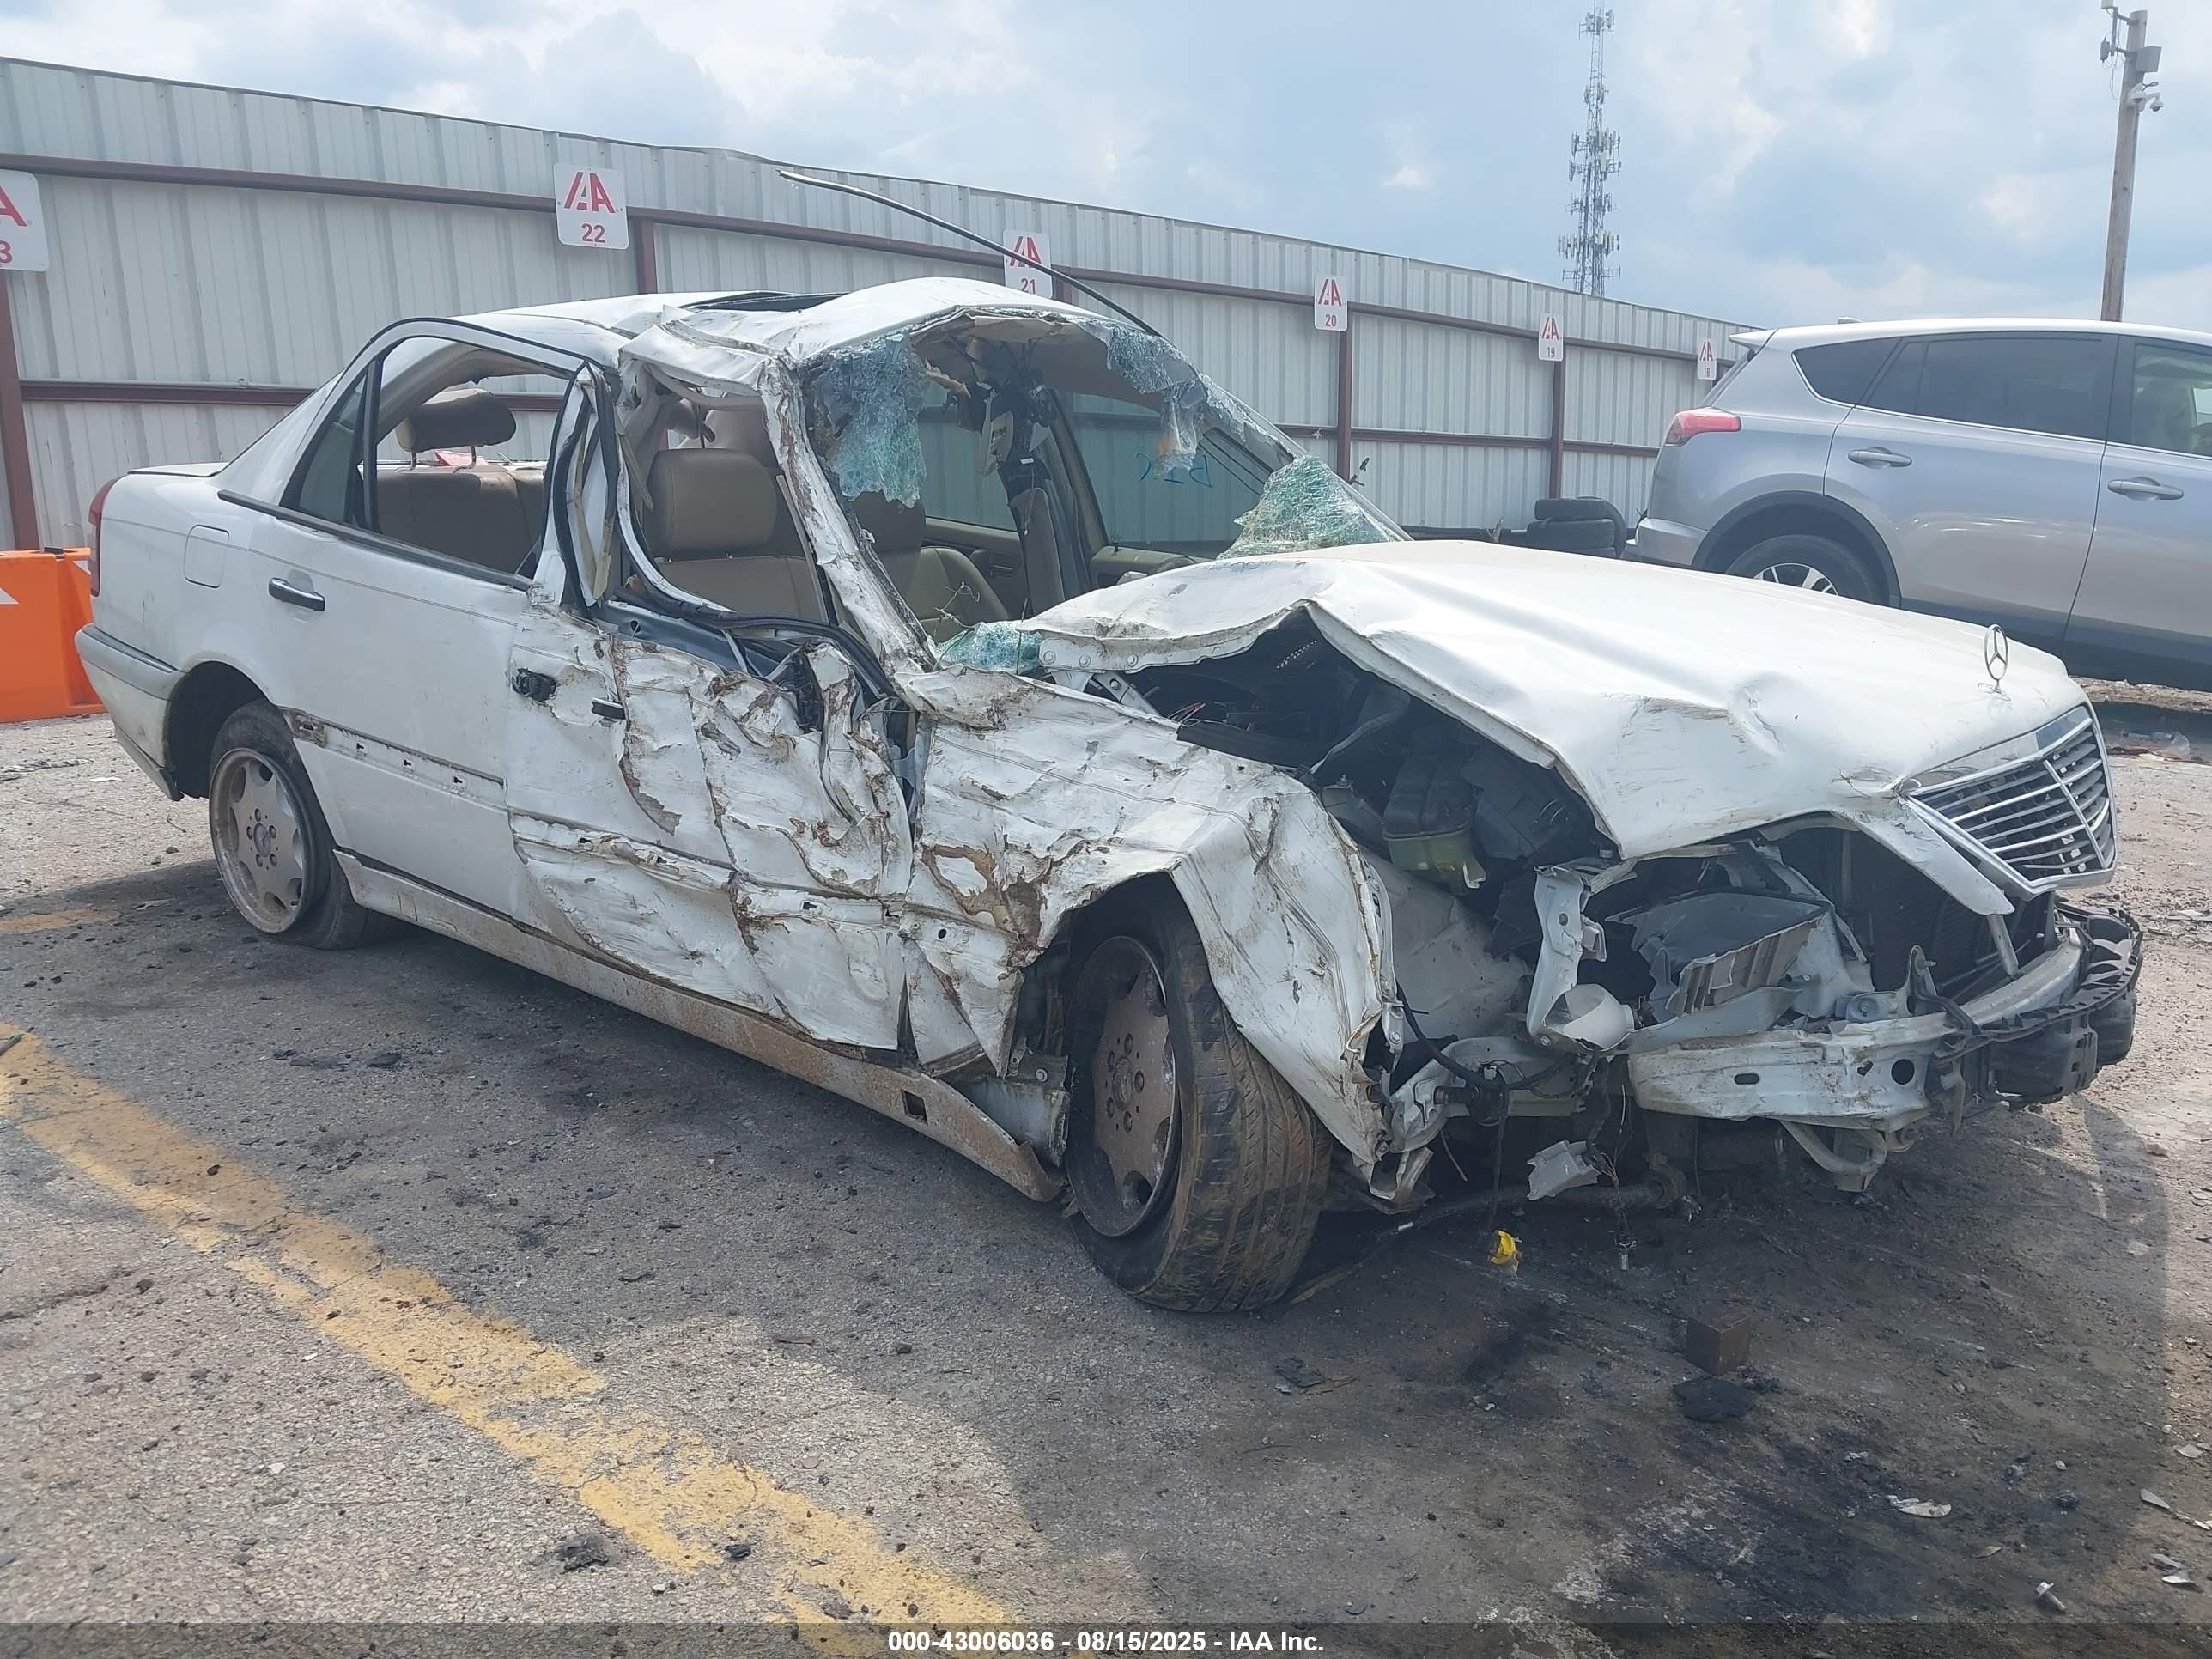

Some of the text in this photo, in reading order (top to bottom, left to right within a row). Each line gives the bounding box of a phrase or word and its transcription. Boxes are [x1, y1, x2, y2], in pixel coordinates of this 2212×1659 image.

[581, 223, 606, 243] 22
[0, 240, 13, 264] 3
[1020, 277, 1036, 294] 21
[1325, 314, 1337, 327] 20
[1547, 347, 1555, 358] 19
[1704, 368, 1711, 378] 18
